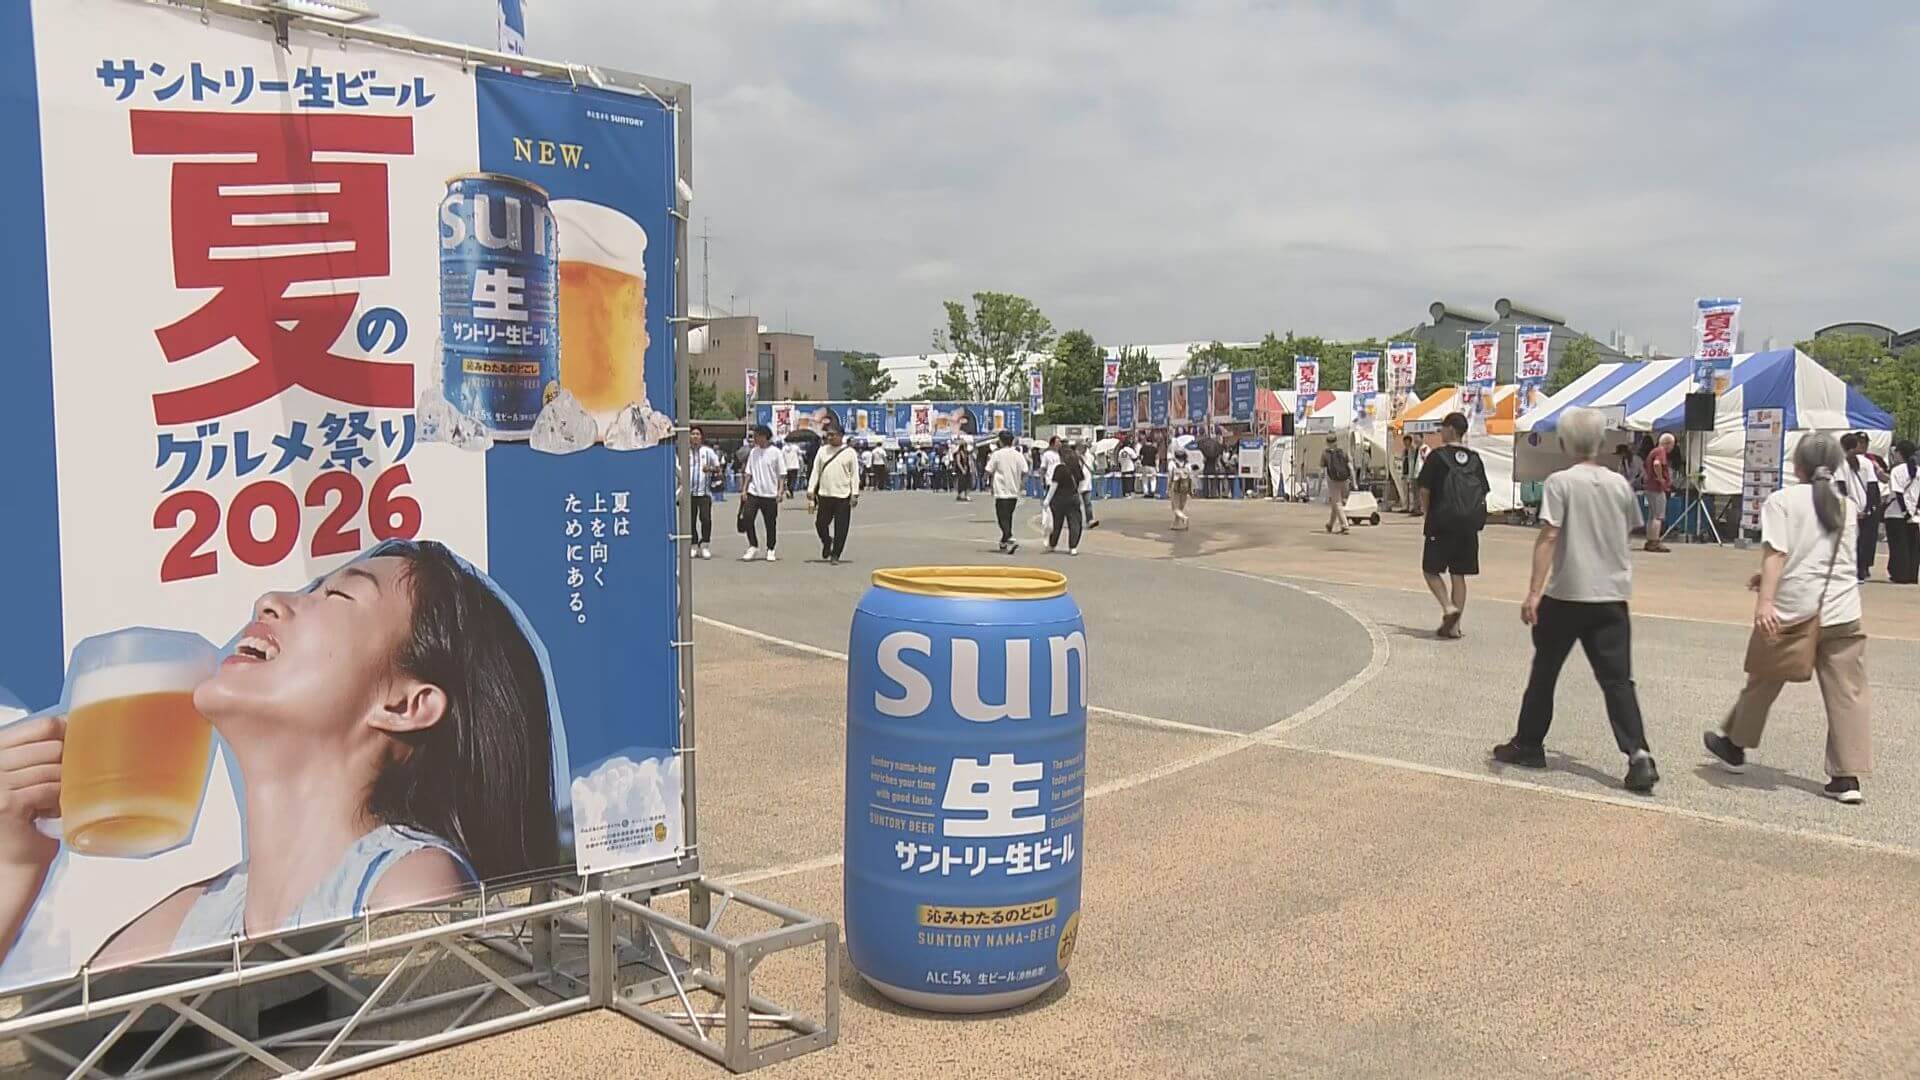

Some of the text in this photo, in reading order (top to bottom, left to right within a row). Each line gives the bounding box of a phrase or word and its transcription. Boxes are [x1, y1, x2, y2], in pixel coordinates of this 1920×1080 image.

[96, 59, 436, 108] サントリー生ビール
[610, 114, 644, 128] SUNTORY
[513, 137, 590, 169] NEW.
[472, 268, 528, 322] 生
[453, 321, 549, 347] サントリー生ビール
[1703, 311, 1735, 344] 夏
[1472, 343, 1494, 369] 夏
[1522, 337, 1546, 364] 夏
[155, 412, 417, 494] グルメ祭り
[152, 464, 422, 583] 2026
[611, 491, 631, 537] 夏は
[564, 493, 586, 624] ためにある。
[588, 492, 608, 586] 上を向く
[873, 630, 1087, 723] sun
[917, 779, 936, 790] time
[941, 753, 1047, 838] 生
[908, 820, 935, 834] BEER
[895, 833, 1075, 876] サントリー生ビール
[918, 924, 1056, 948] SUNTORY NAMA-BEER
